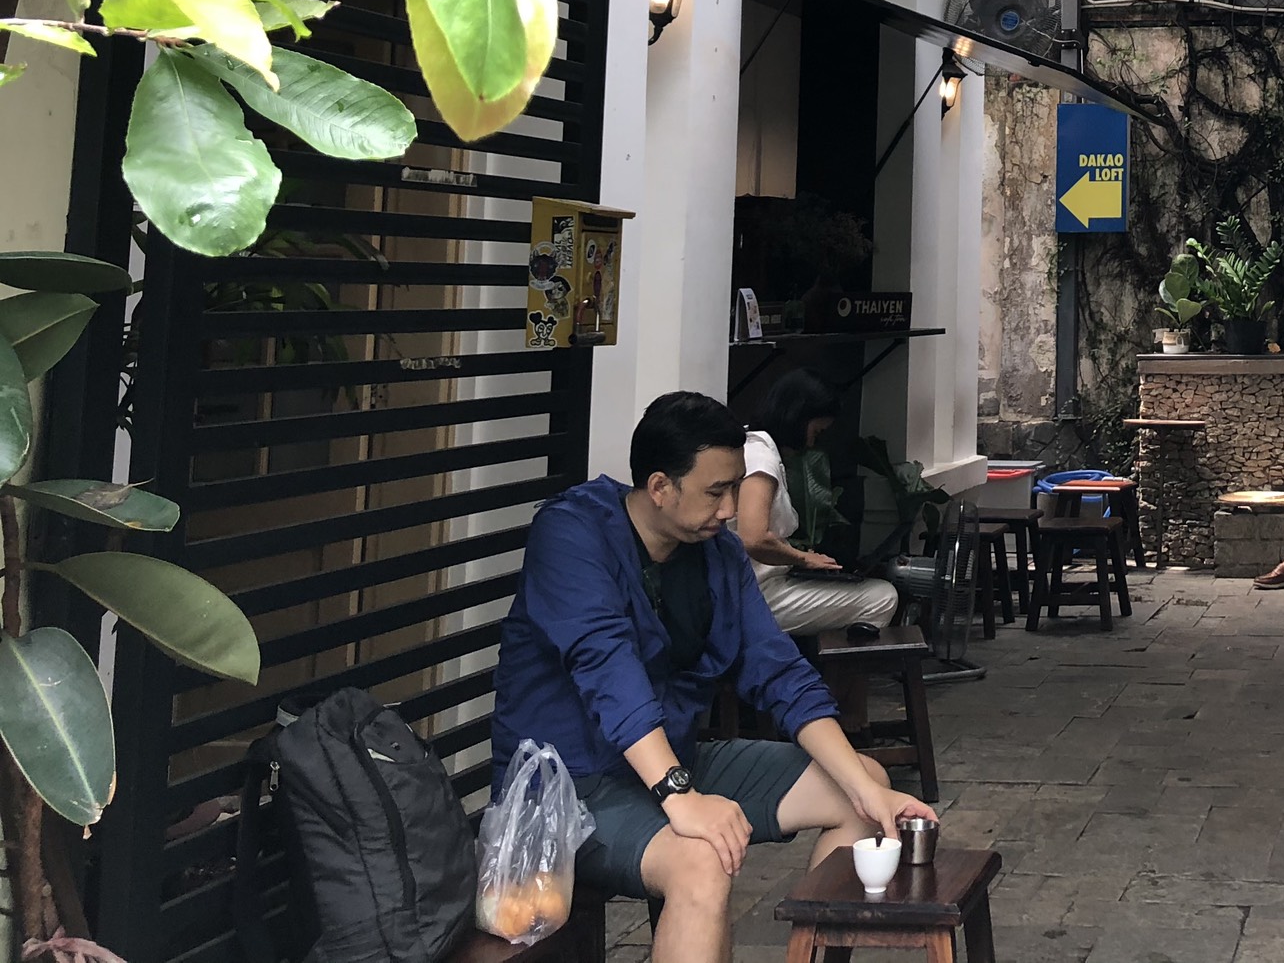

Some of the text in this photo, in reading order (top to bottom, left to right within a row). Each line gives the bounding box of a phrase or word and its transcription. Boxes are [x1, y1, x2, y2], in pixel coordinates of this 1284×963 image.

[1079, 154, 1124, 167] DAKAO
[1095, 168, 1124, 181] LOFT
[854, 300, 903, 314] THAIYEN
